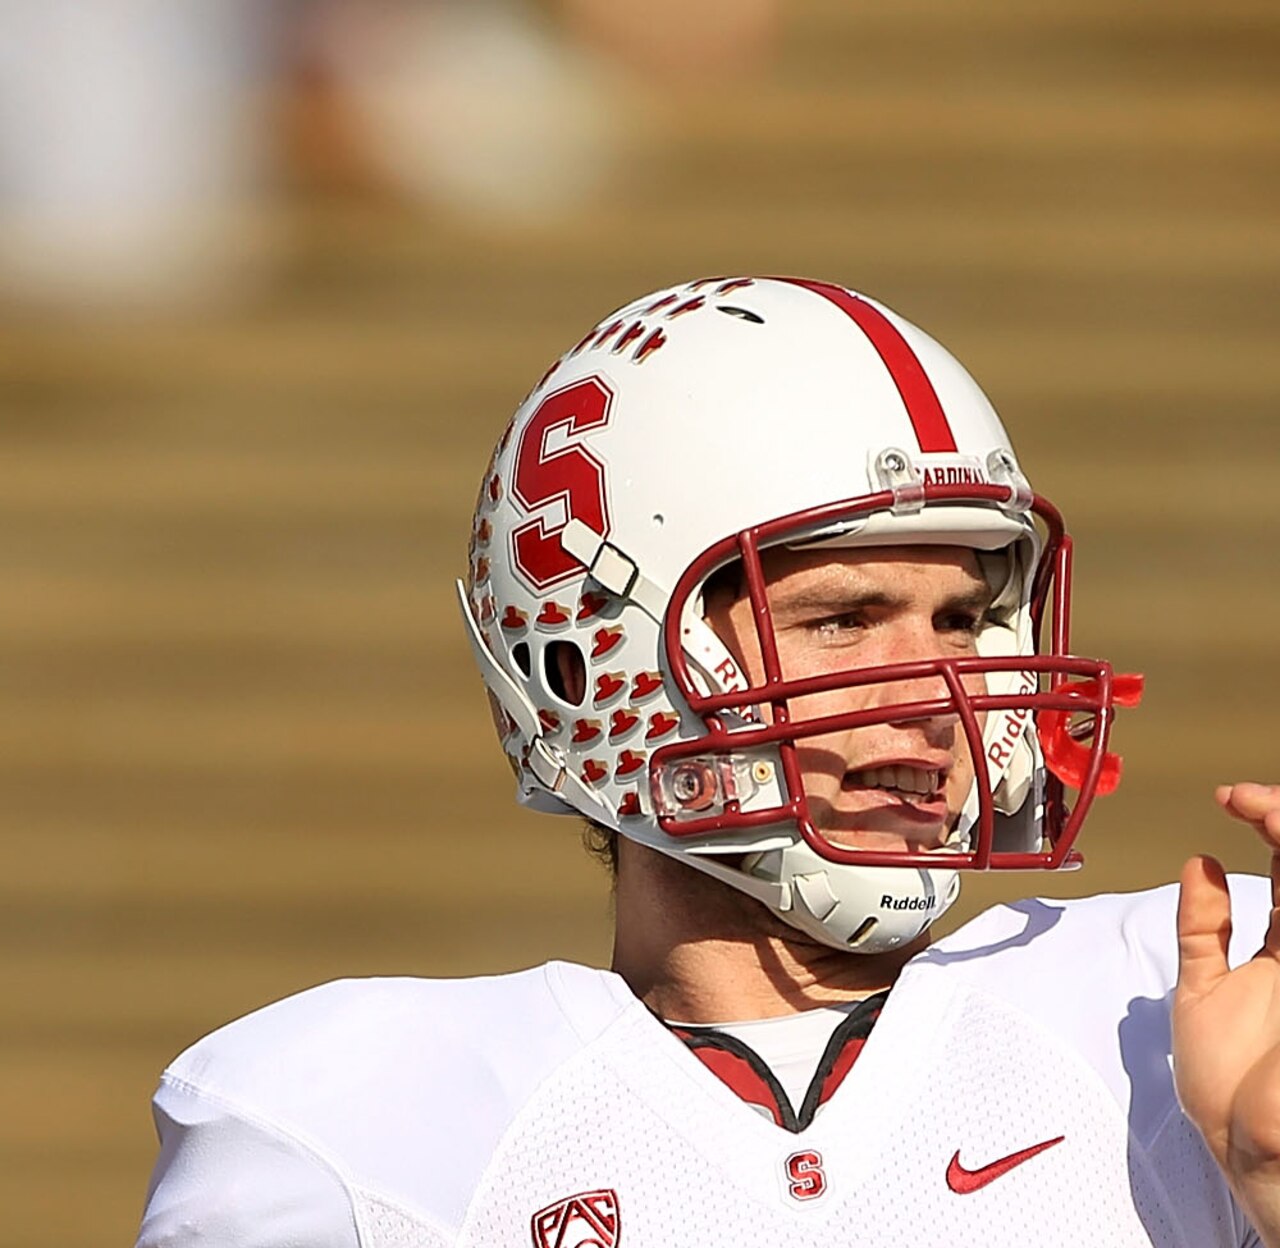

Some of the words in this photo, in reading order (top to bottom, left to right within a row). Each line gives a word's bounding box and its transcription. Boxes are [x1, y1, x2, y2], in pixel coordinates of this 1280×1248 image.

[512, 374, 614, 591] S
[880, 894, 937, 911] Riddell
[784, 1148, 828, 1202] S
